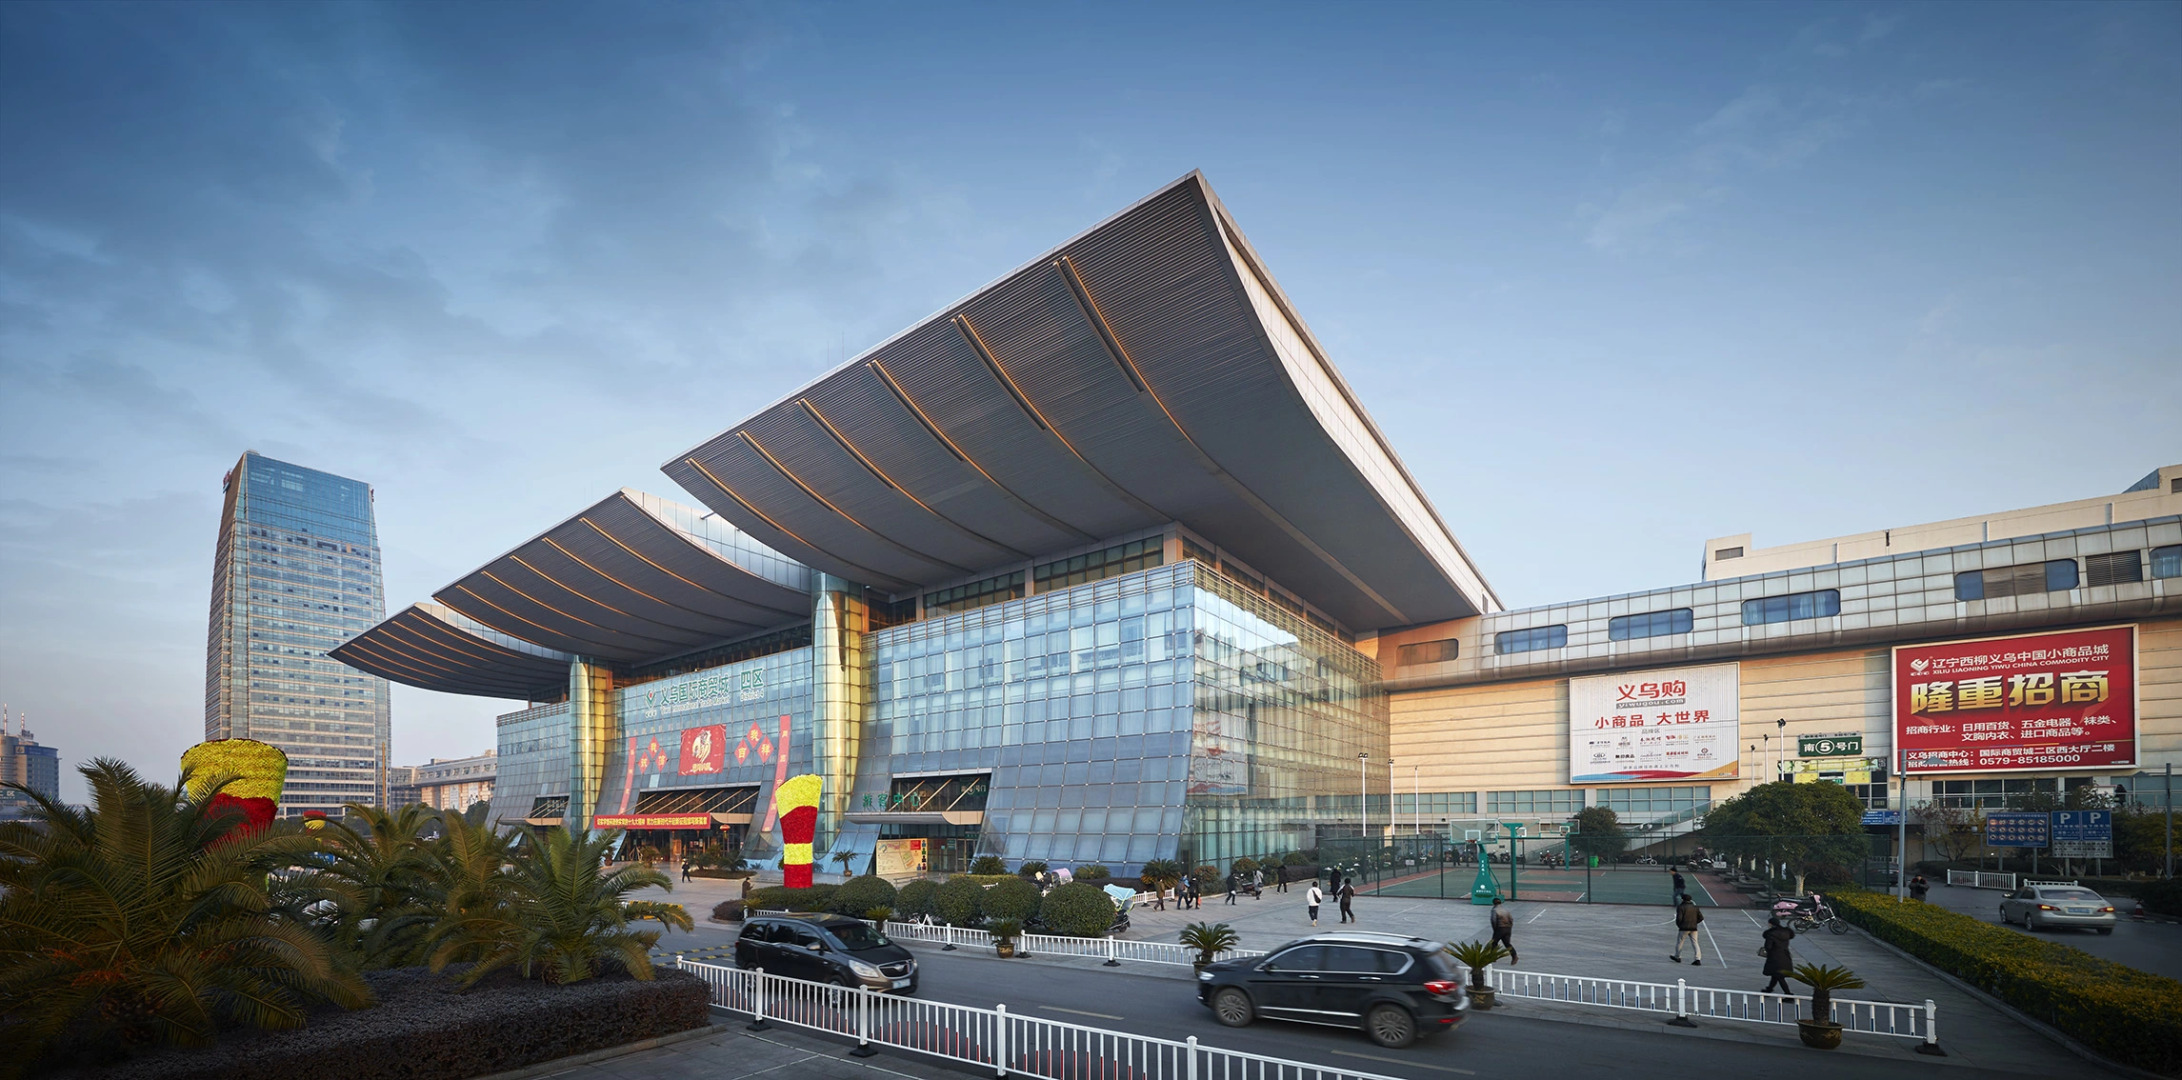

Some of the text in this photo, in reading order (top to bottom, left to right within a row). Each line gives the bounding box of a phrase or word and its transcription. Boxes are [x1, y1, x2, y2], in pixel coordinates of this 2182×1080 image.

[1932, 643, 2109, 669] 辽宁西柳义乌中国小商品城
[1952, 665, 1989, 673] LIAONING
[2012, 661, 2038, 669] CHINA
[2039, 656, 2089, 666] COMMODITY
[2091, 654, 2110, 662] CITY
[661, 668, 764, 705] 义乌国际商贸城 四区
[1616, 680, 1686, 701] 义乌购
[1910, 669, 2110, 715] 隆重招商
[1594, 709, 1710, 729] 小商品 大世界
[1979, 743, 2116, 757] 国际商贸城二区西大厅二楼
[1979, 754, 2081, 766] 0579-85185000
[2060, 812, 2101, 824] P P
